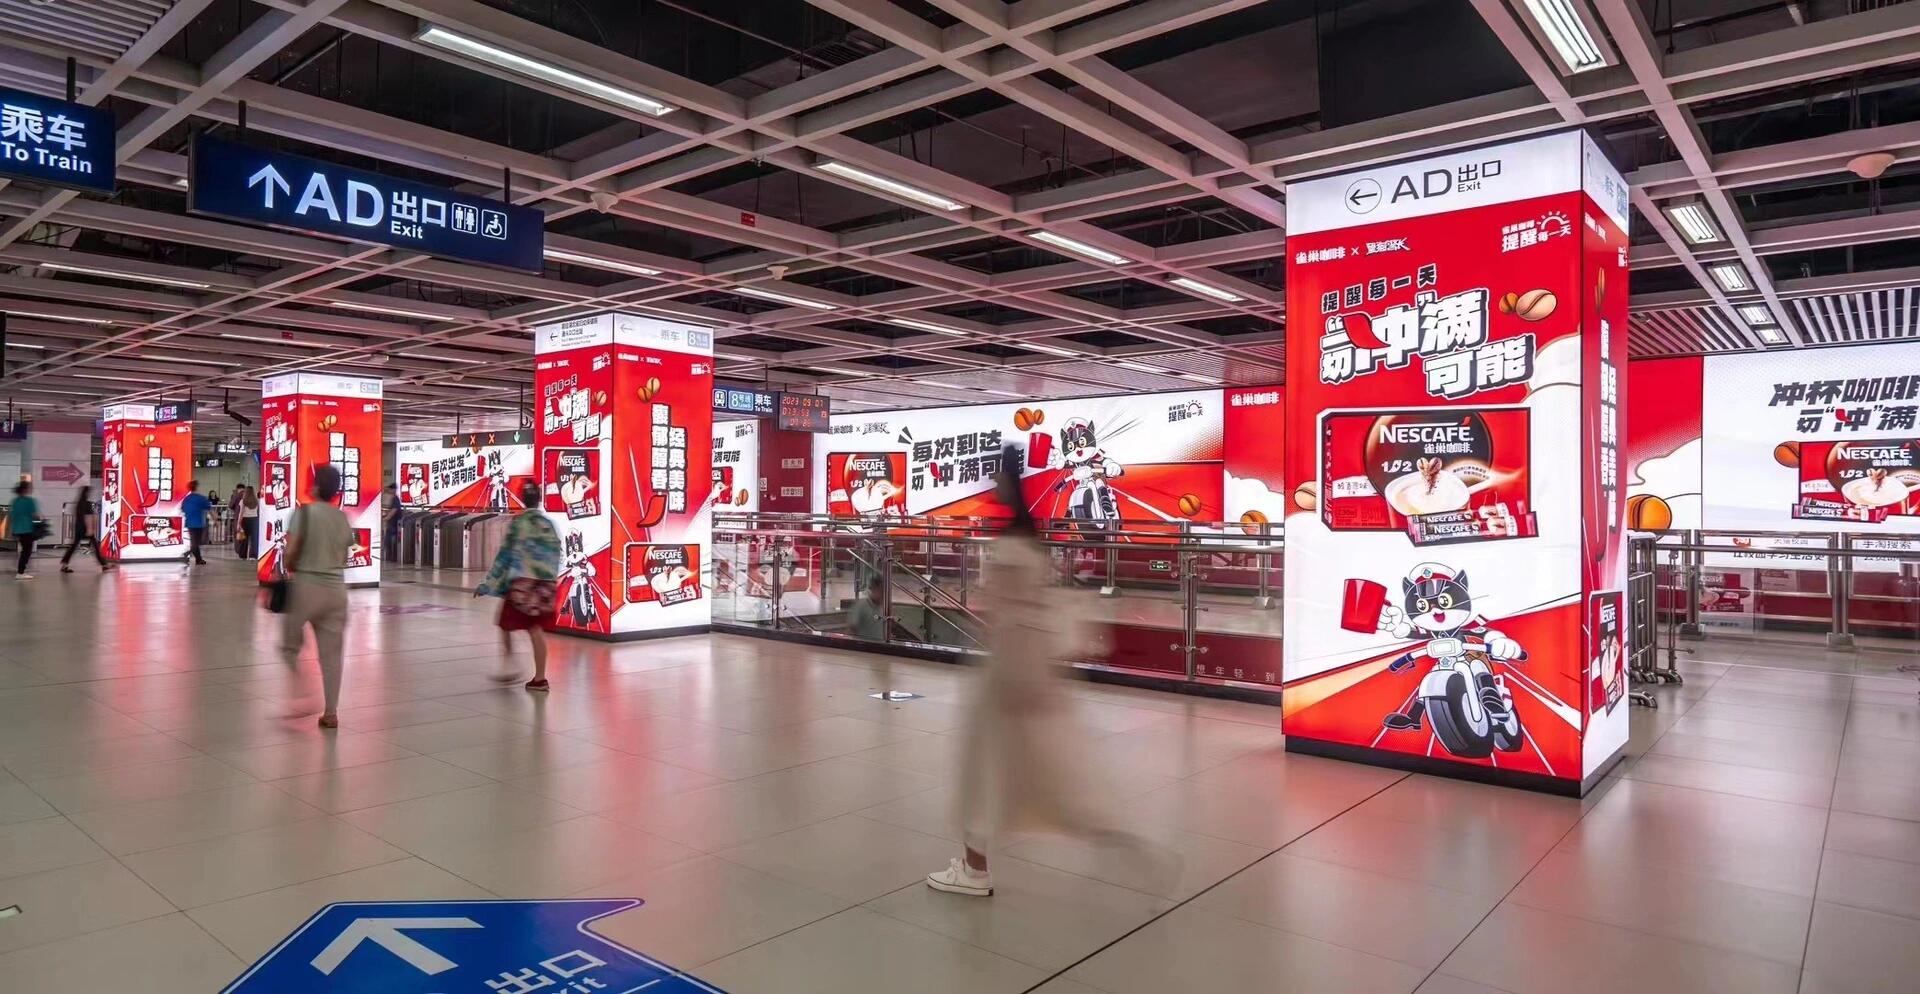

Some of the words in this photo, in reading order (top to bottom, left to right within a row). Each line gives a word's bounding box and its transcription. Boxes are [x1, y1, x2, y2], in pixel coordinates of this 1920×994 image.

[1, 105, 87, 151] 乘车
[1, 141, 28, 162] To
[36, 147, 93, 175] Train
[1457, 159, 1502, 183] 出口
[295, 172, 385, 228] AD
[1390, 168, 1452, 204] AD
[1457, 181, 1481, 193] Exit
[390, 190, 447, 228] 出口
[391, 220, 423, 240] Exit
[1322, 264, 1435, 312] 提醒每一天
[1424, 334, 1535, 399] 可能
[731, 393, 738, 406] 8
[754, 393, 772, 405] 乘车
[1231, 392, 1280, 406] 雀巢咖啡
[1768, 375, 1920, 406] 冲杯咖啡
[913, 430, 1002, 462] 每次到达
[484, 949, 607, 994] 出口
